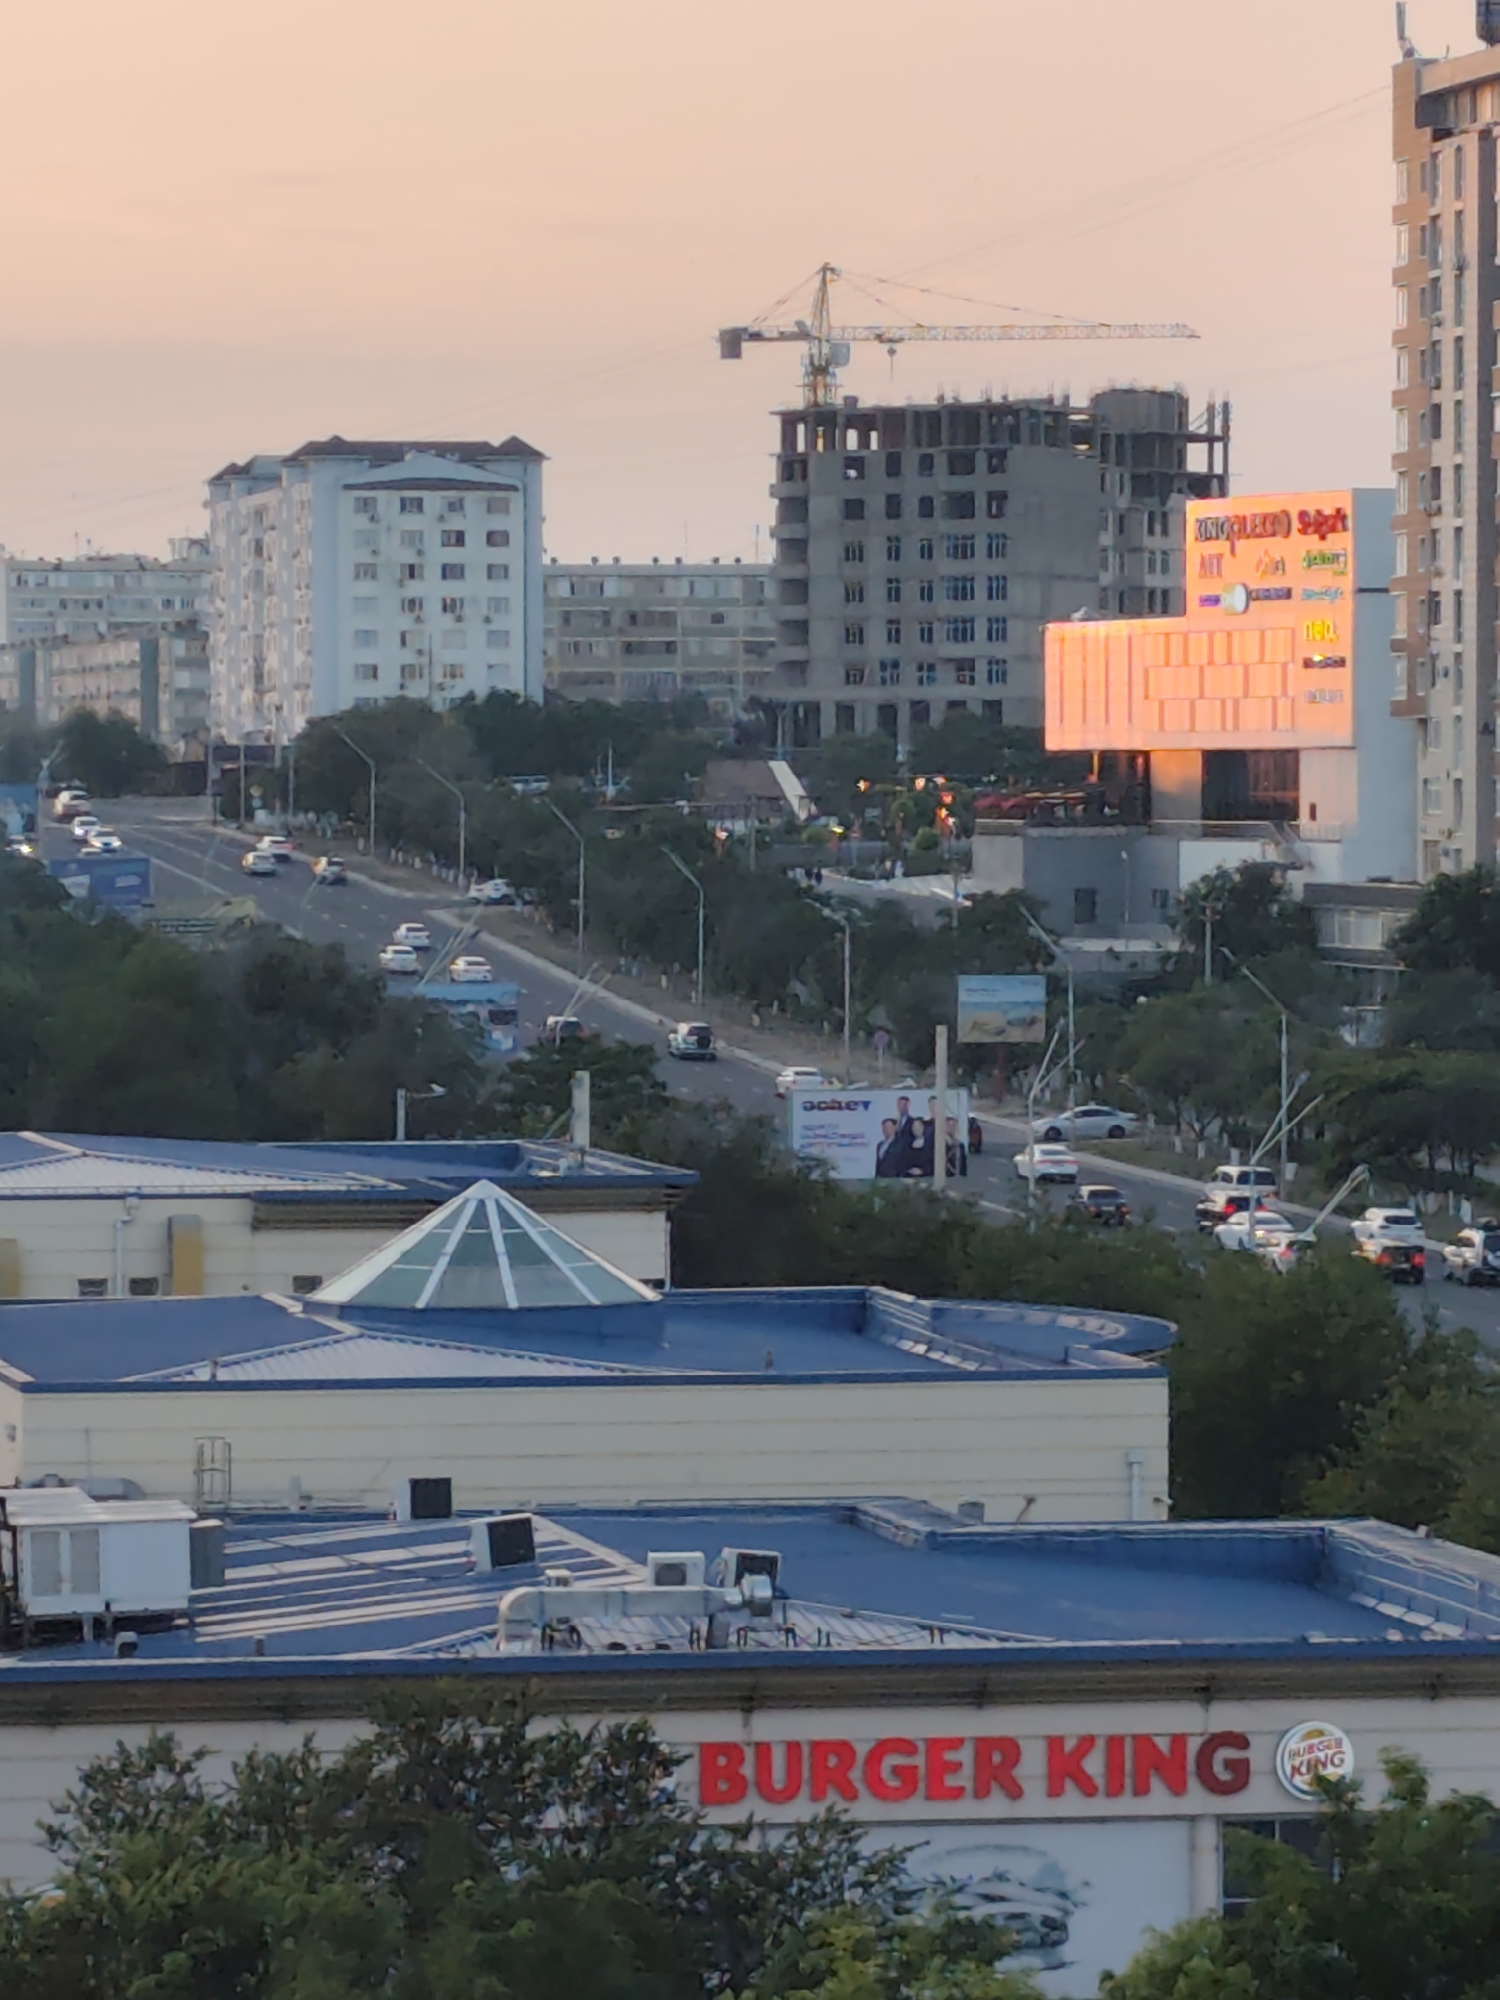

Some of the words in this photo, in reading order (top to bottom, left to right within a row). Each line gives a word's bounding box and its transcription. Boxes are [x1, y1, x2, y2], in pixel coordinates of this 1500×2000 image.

[1288, 1737, 1343, 1762] BURGER
[699, 1737, 1023, 1805] BURGER
[1045, 1731, 1251, 1797] KING
[1289, 1750, 1346, 1783] KING
